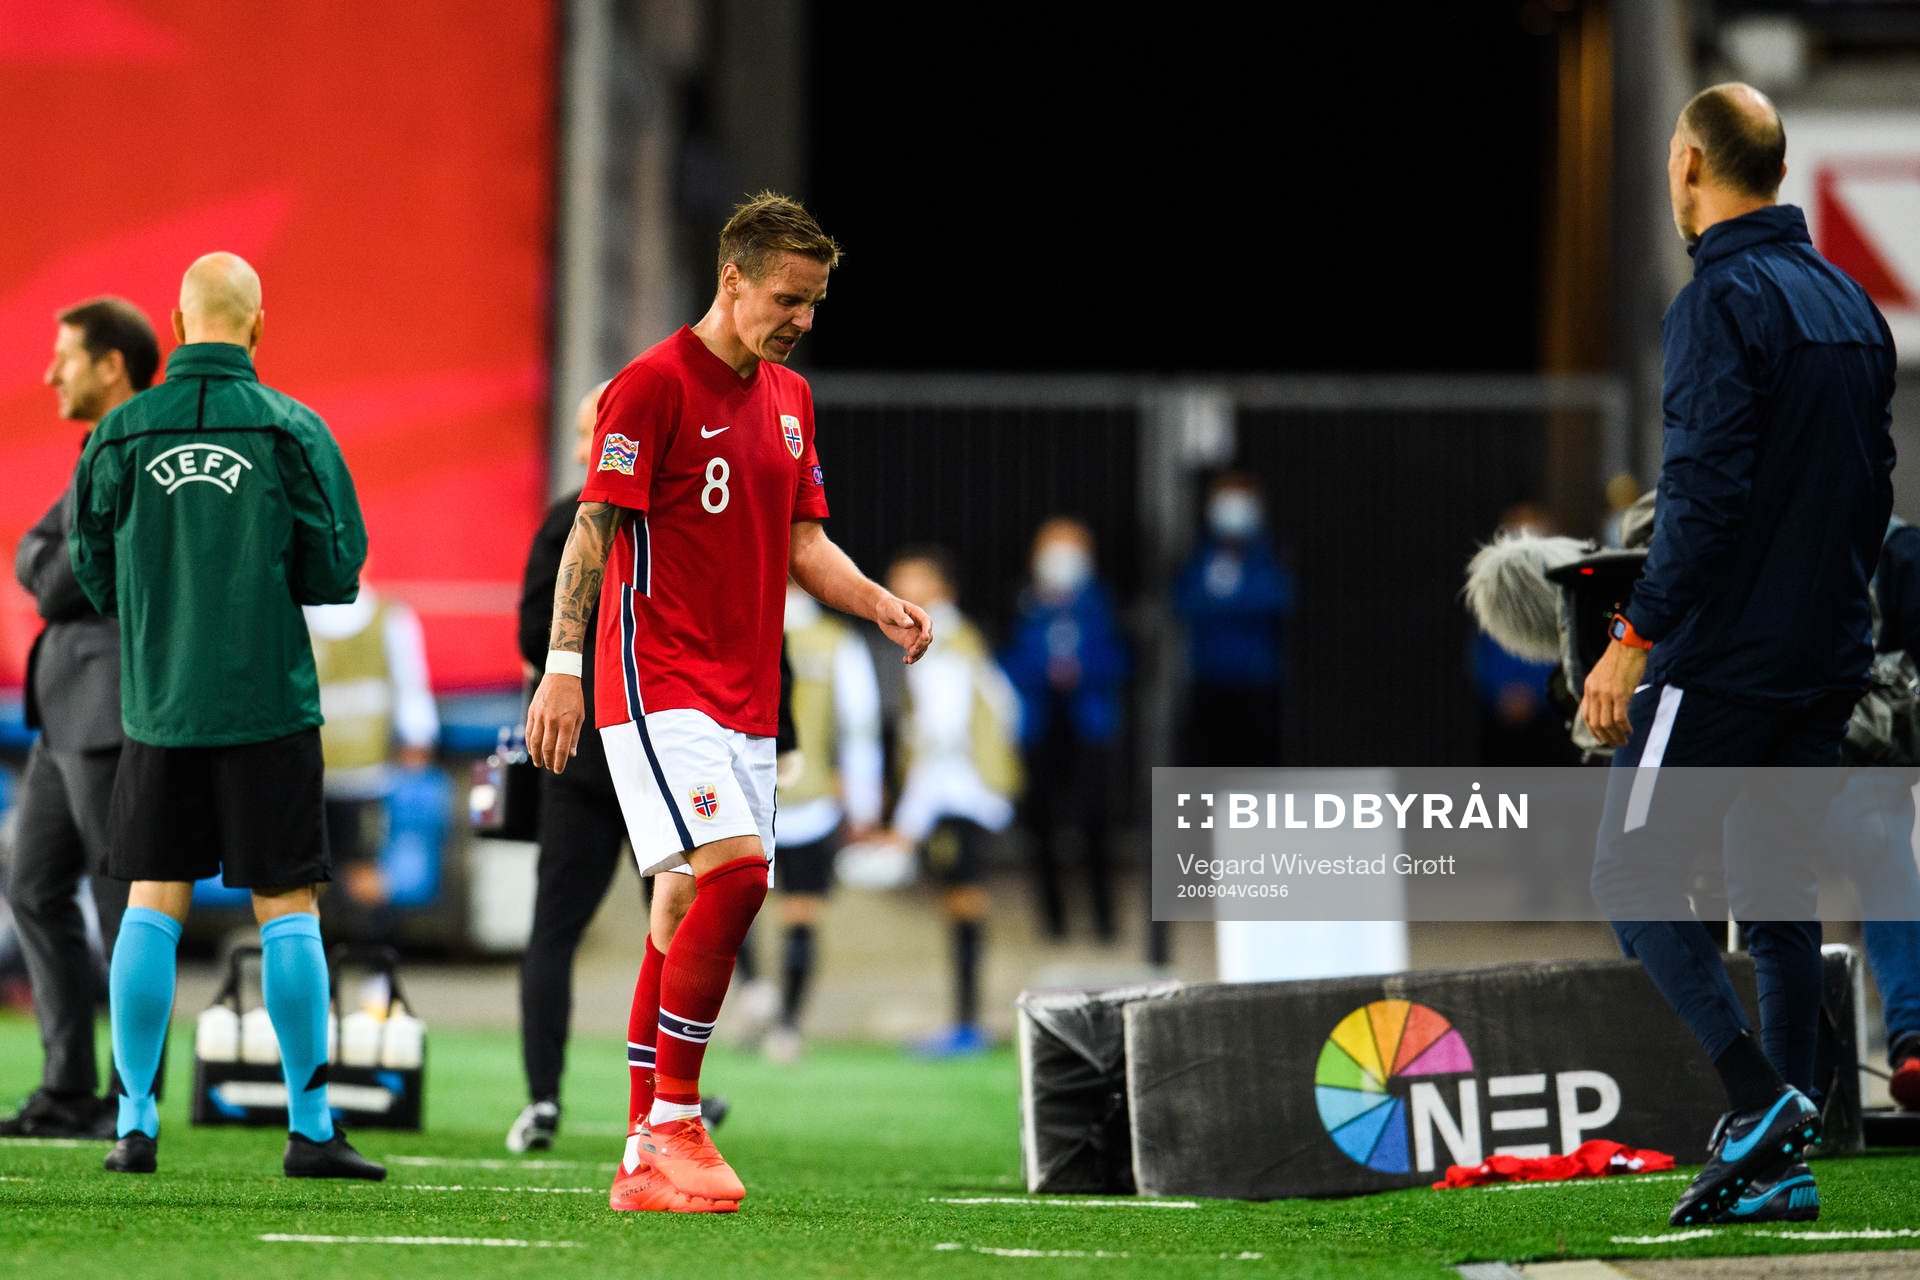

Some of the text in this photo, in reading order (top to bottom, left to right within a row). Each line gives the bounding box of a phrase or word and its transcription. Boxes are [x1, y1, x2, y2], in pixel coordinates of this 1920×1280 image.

[152, 451, 242, 488] UEFA
[701, 456, 730, 514] 8
[1410, 1070, 1622, 1173] NEP
